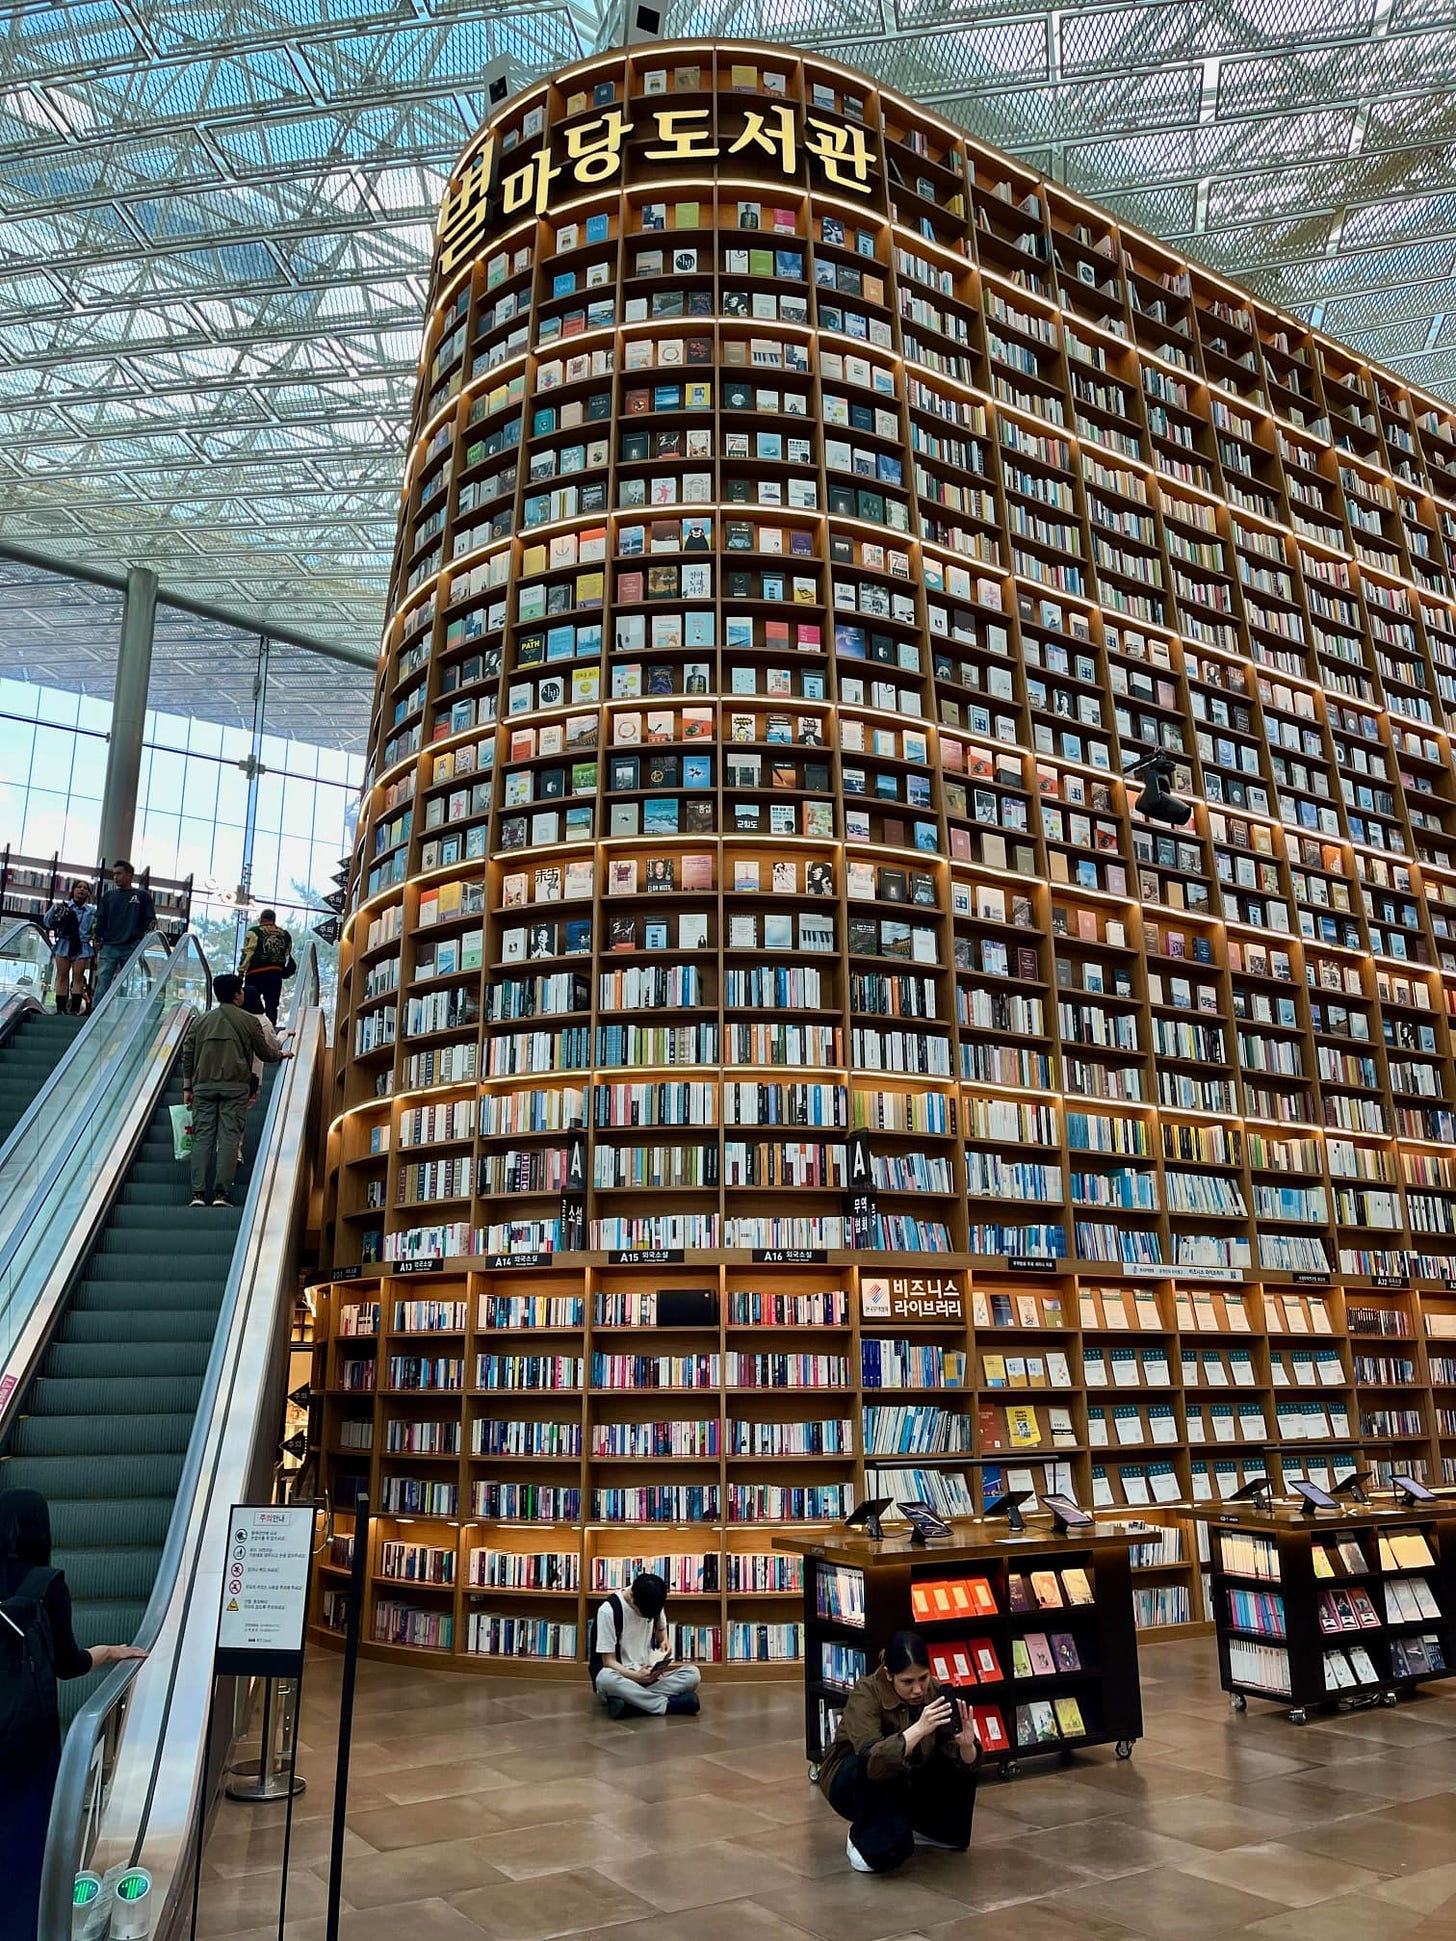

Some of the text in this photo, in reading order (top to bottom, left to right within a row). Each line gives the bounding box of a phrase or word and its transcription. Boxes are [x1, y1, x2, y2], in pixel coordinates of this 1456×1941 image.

[520, 639, 541, 651] PATH
[570, 1140, 583, 1179] A
[853, 1140, 866, 1178] A
[495, 1257, 512, 1268] A14
[620, 1251, 640, 1264] A15
[773, 1250, 794, 1263] A16
[893, 1279, 960, 1299] 비즈니스
[894, 1300, 962, 1318] 라이브러리
